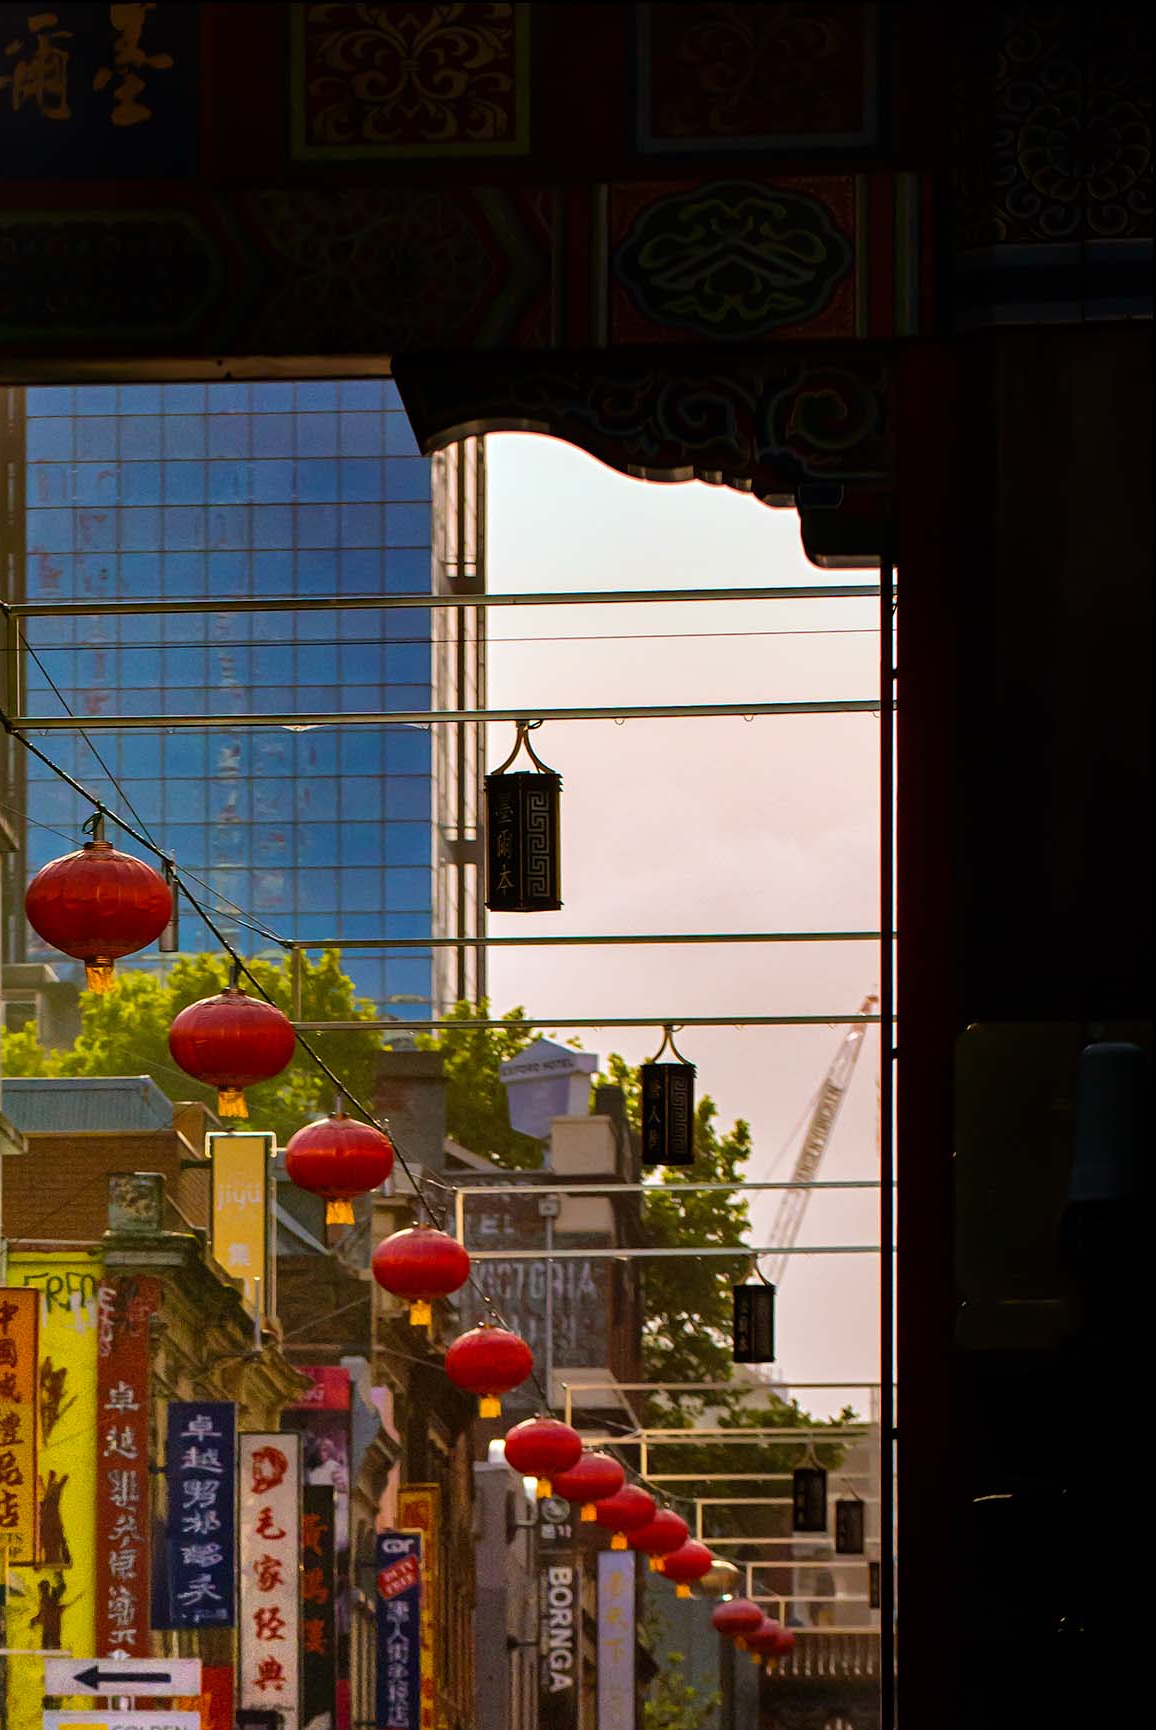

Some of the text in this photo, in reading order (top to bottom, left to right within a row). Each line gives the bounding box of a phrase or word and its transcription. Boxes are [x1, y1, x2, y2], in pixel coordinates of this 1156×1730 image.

[254, 1507, 287, 1691] 毛家经典
[548, 1566, 574, 1693] BORNGA
